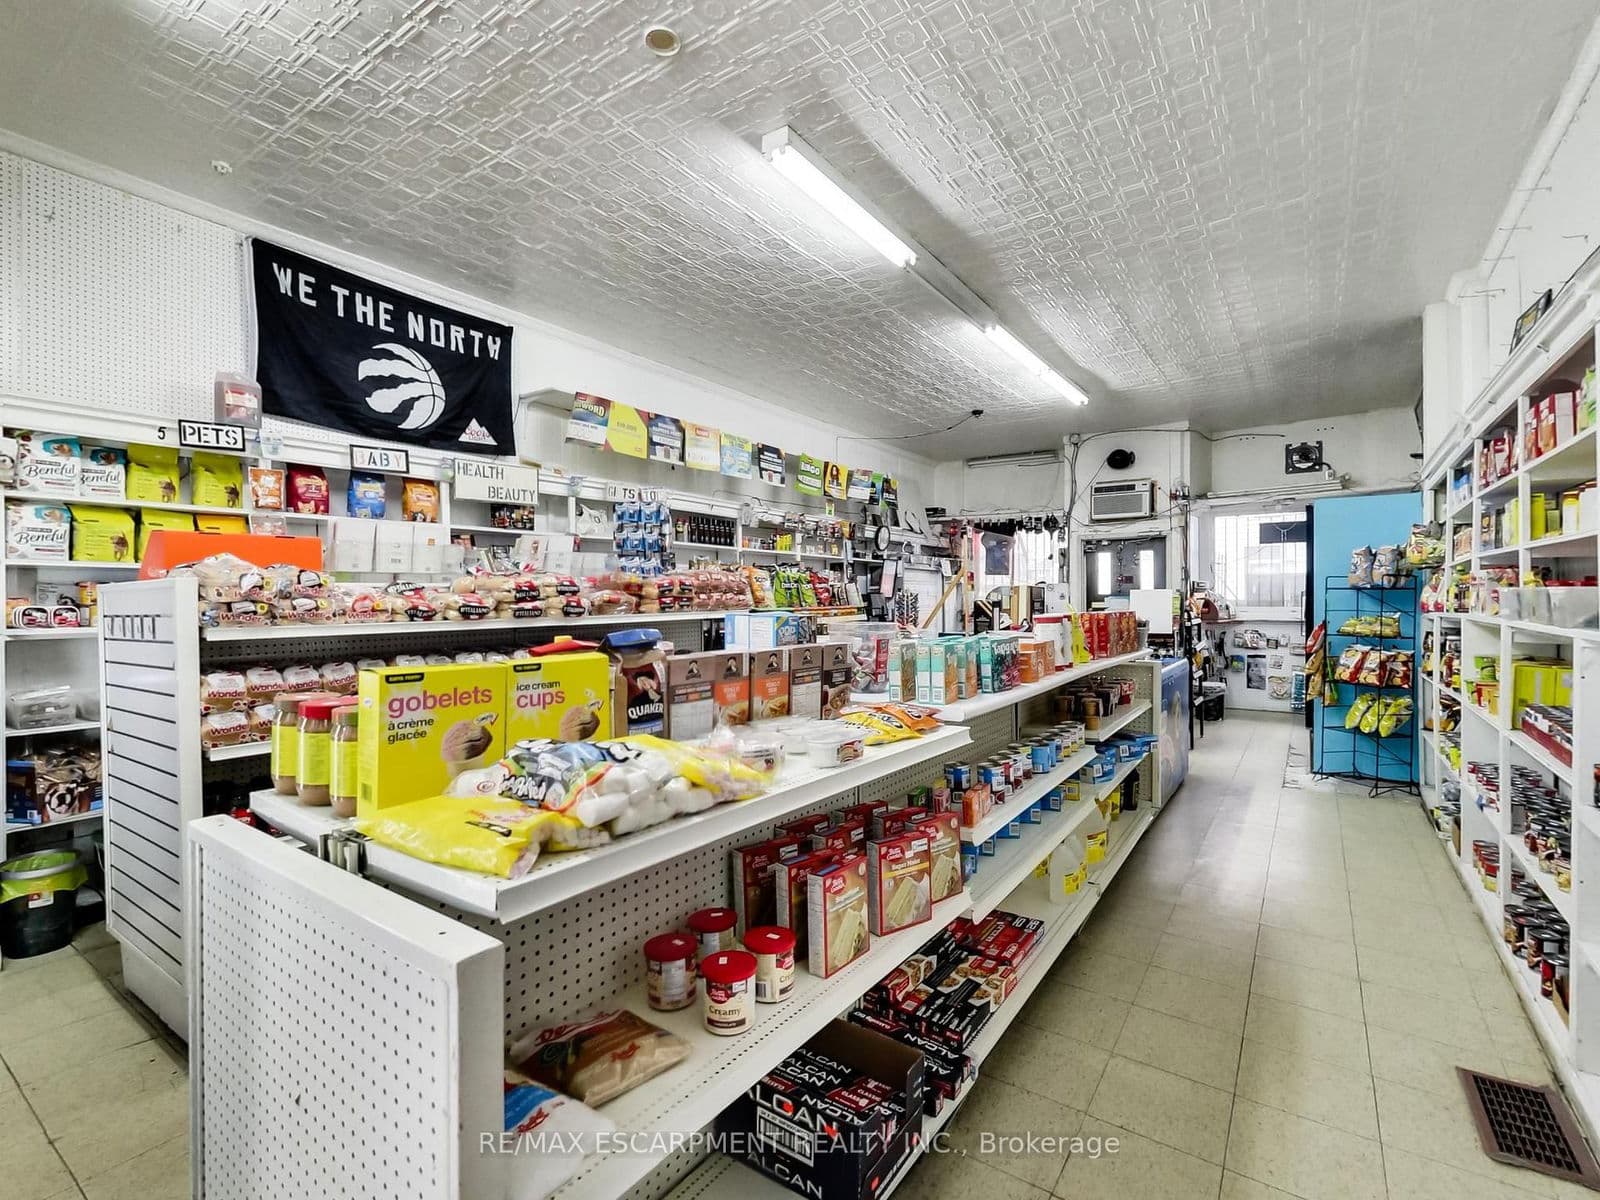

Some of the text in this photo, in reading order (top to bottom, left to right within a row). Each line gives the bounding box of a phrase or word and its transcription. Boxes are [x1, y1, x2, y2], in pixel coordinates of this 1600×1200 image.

[272, 262, 501, 360] WE THE NORTH
[157, 426, 168, 440] 5
[182, 424, 238, 446] PETS
[355, 448, 401, 467] BABY
[24, 463, 76, 478] Beneful
[457, 462, 504, 480] HEALTH
[488, 486, 536, 501] BEAUTY
[15, 531, 67, 545] Beneful
[288, 679, 320, 691] Wonder
[516, 680, 561, 692] ice cream
[208, 689, 246, 699] Wonder
[516, 689, 566, 711] cups
[388, 686, 493, 719] gobelets
[628, 702, 664, 719] QUAKER
[388, 716, 435, 731] à crème
[388, 729, 427, 745] glacée
[709, 1005, 742, 1017] Creamy
[777, 1063, 825, 1087] LCAN
[785, 1057, 842, 1085] ALCAN
